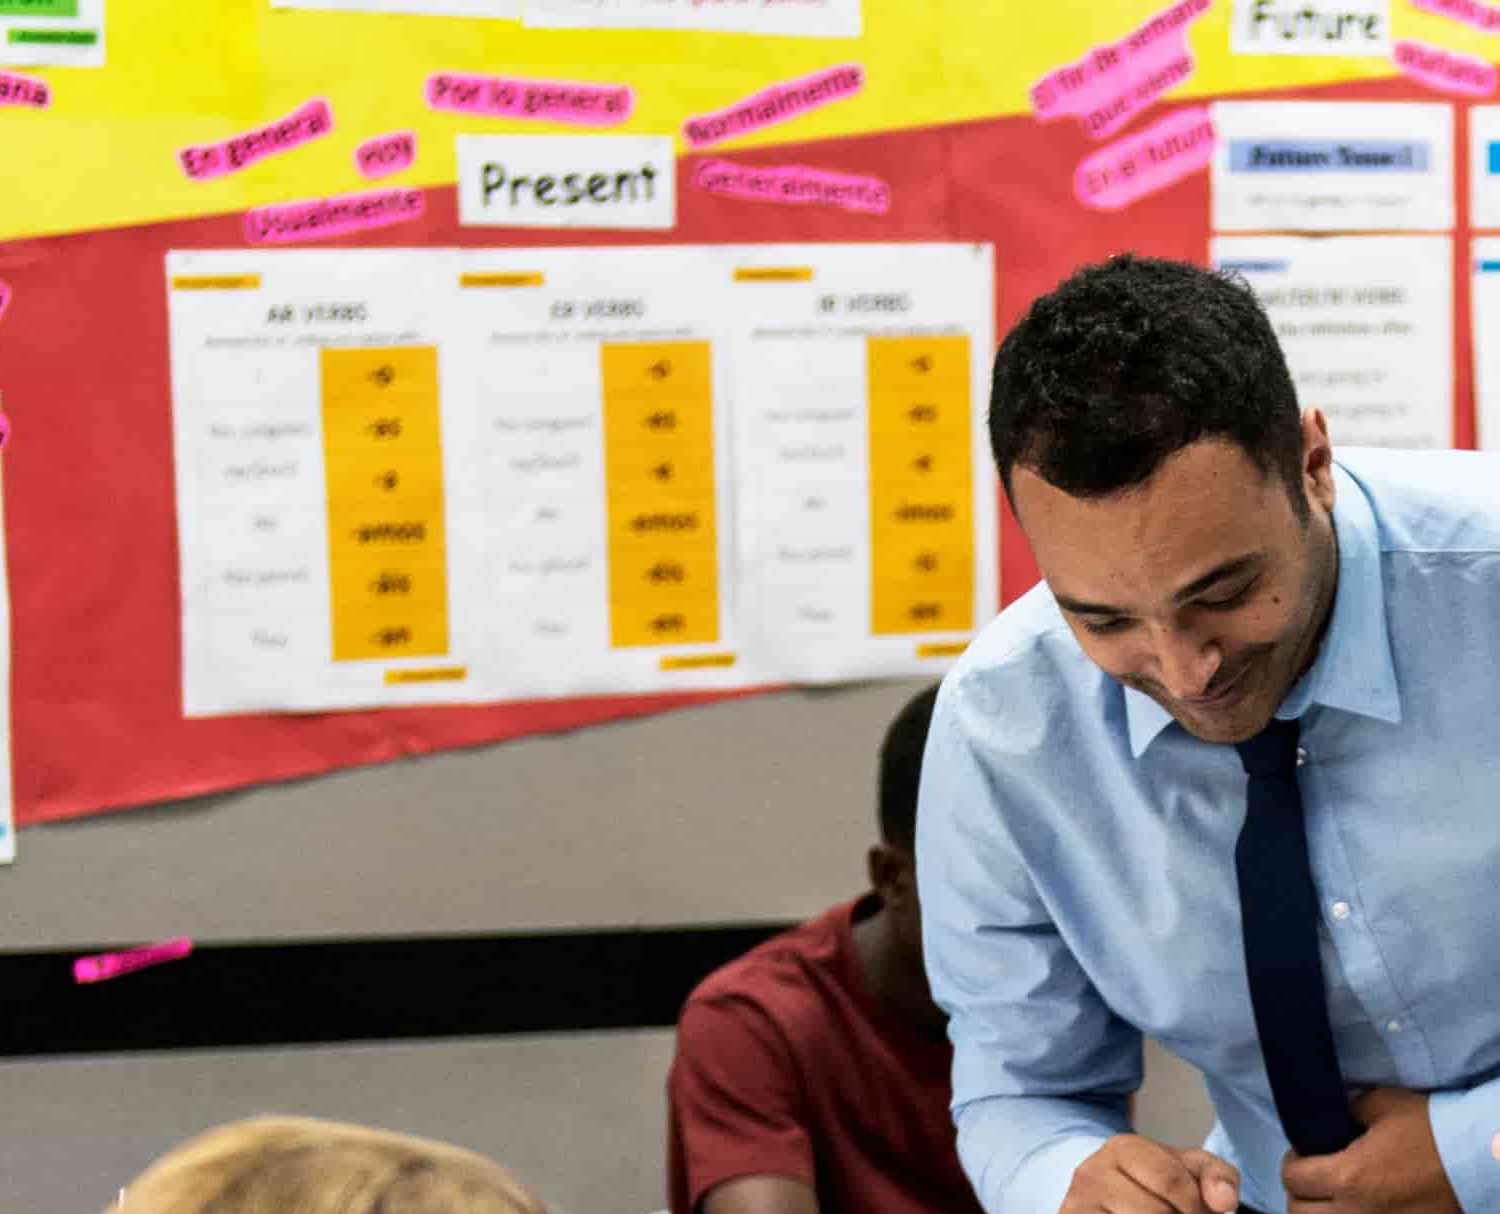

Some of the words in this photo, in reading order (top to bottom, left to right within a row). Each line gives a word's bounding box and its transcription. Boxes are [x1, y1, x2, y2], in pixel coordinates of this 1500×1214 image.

[1128, 0, 1211, 51] seman
[1250, 0, 1380, 40] Future
[434, 76, 469, 102] Por
[522, 86, 624, 120] general
[689, 67, 863, 146] Normalmente
[184, 146, 213, 176] En
[228, 112, 326, 163] general
[1148, 121, 1216, 160] futur
[482, 162, 657, 206] Present
[251, 191, 422, 236] Usualmente
